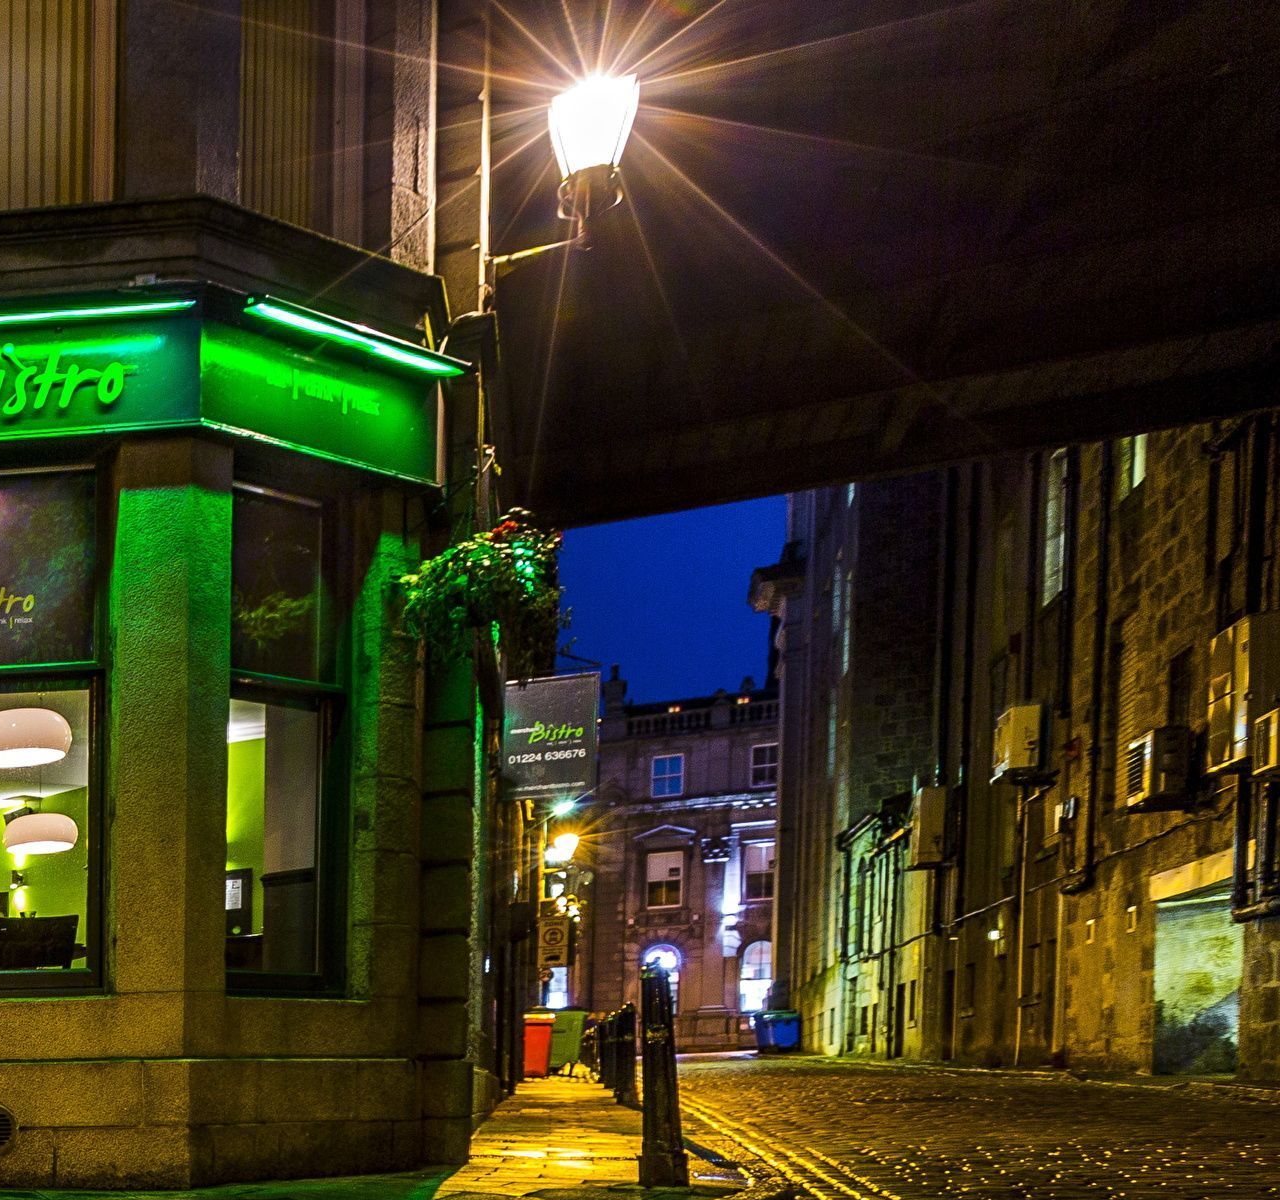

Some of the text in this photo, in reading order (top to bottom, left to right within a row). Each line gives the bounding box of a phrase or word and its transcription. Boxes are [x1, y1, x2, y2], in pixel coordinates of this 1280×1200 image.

[528, 721, 584, 744] Bistro
[508, 748, 586, 765] 01224 636676
